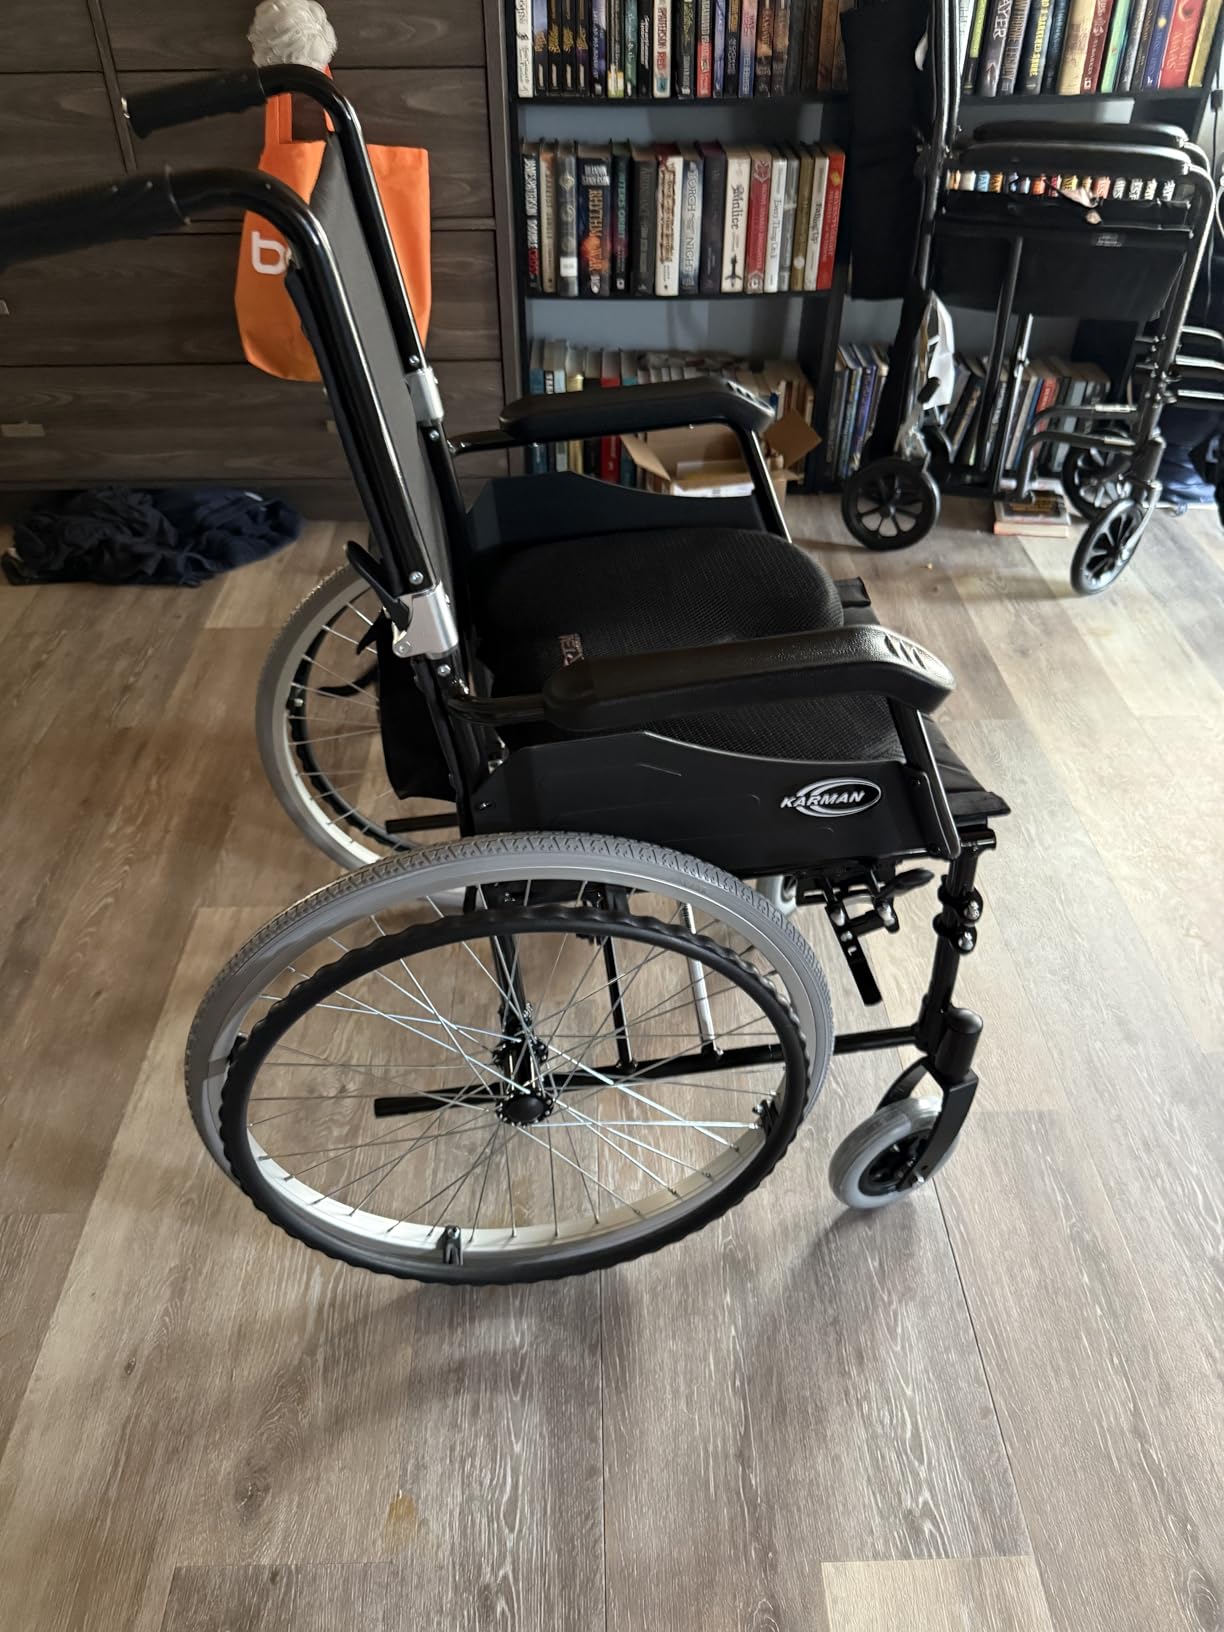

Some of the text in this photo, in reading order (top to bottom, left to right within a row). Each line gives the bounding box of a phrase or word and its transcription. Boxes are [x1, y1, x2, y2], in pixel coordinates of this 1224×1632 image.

[658, 7, 667, 48] PATTERSON
[525, 180, 538, 215] PATTERSON
[687, 170, 698, 212] TORCH
[731, 184, 744, 230] Malice
[526, 219, 538, 249] DOUBLE
[588, 189, 603, 271] RHYTHM WAR
[618, 210, 626, 240] ORBIT
[779, 790, 865, 809] KARMAN
